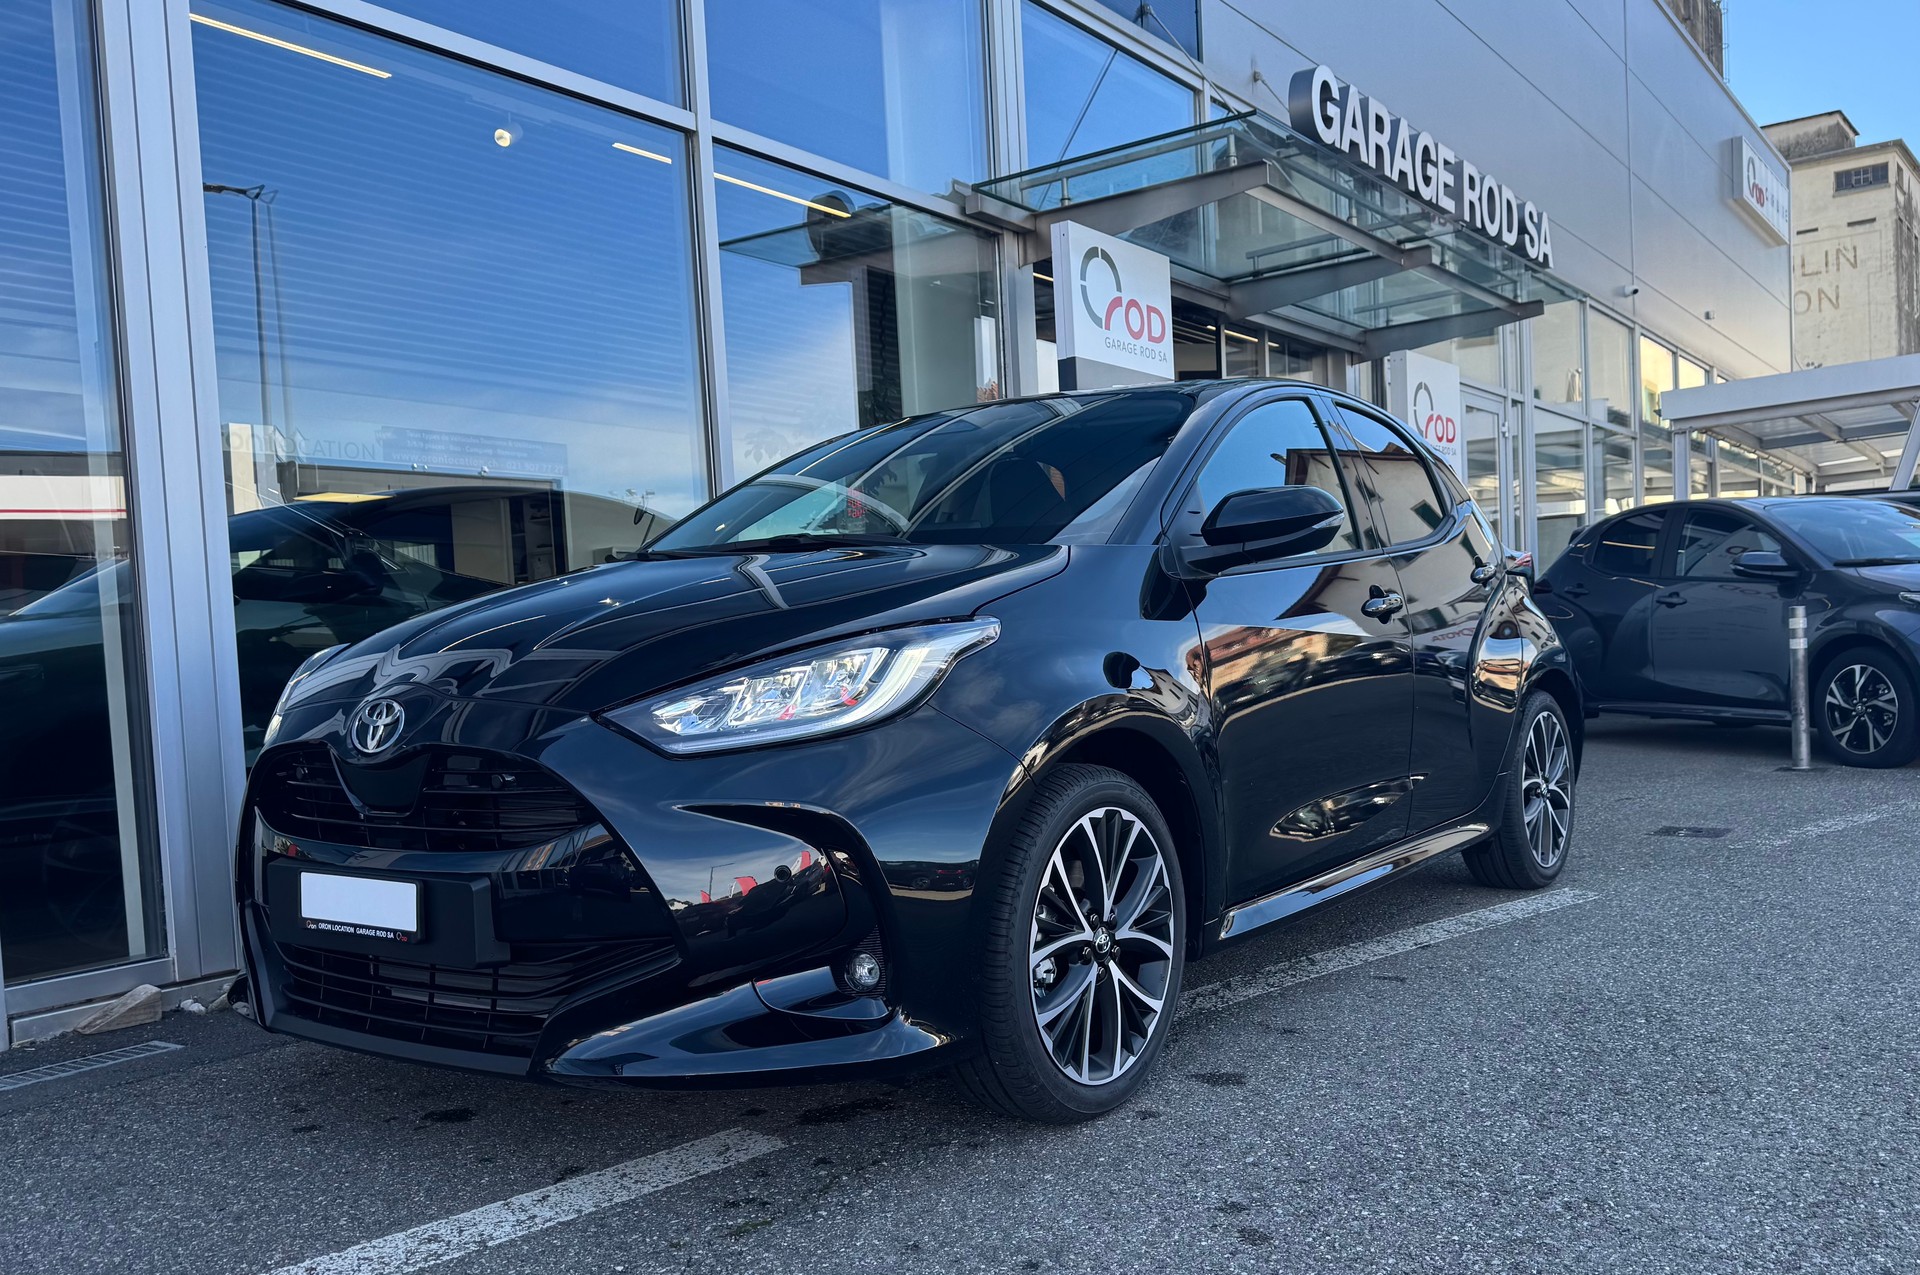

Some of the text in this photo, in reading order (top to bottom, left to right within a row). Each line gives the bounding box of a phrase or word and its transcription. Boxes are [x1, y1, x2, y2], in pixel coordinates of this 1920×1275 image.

[1310, 64, 1554, 269] GARAGE ROD SA
[1793, 245, 1858, 277] LIN
[1104, 337, 1168, 363] GARAGE ROD SA
[318, 922, 332, 931] ORON
[332, 924, 355, 934] LOCATION
[356, 927, 376, 937] GARAGE
[376, 930, 387, 938] ROD
[387, 931, 395, 939] SA
